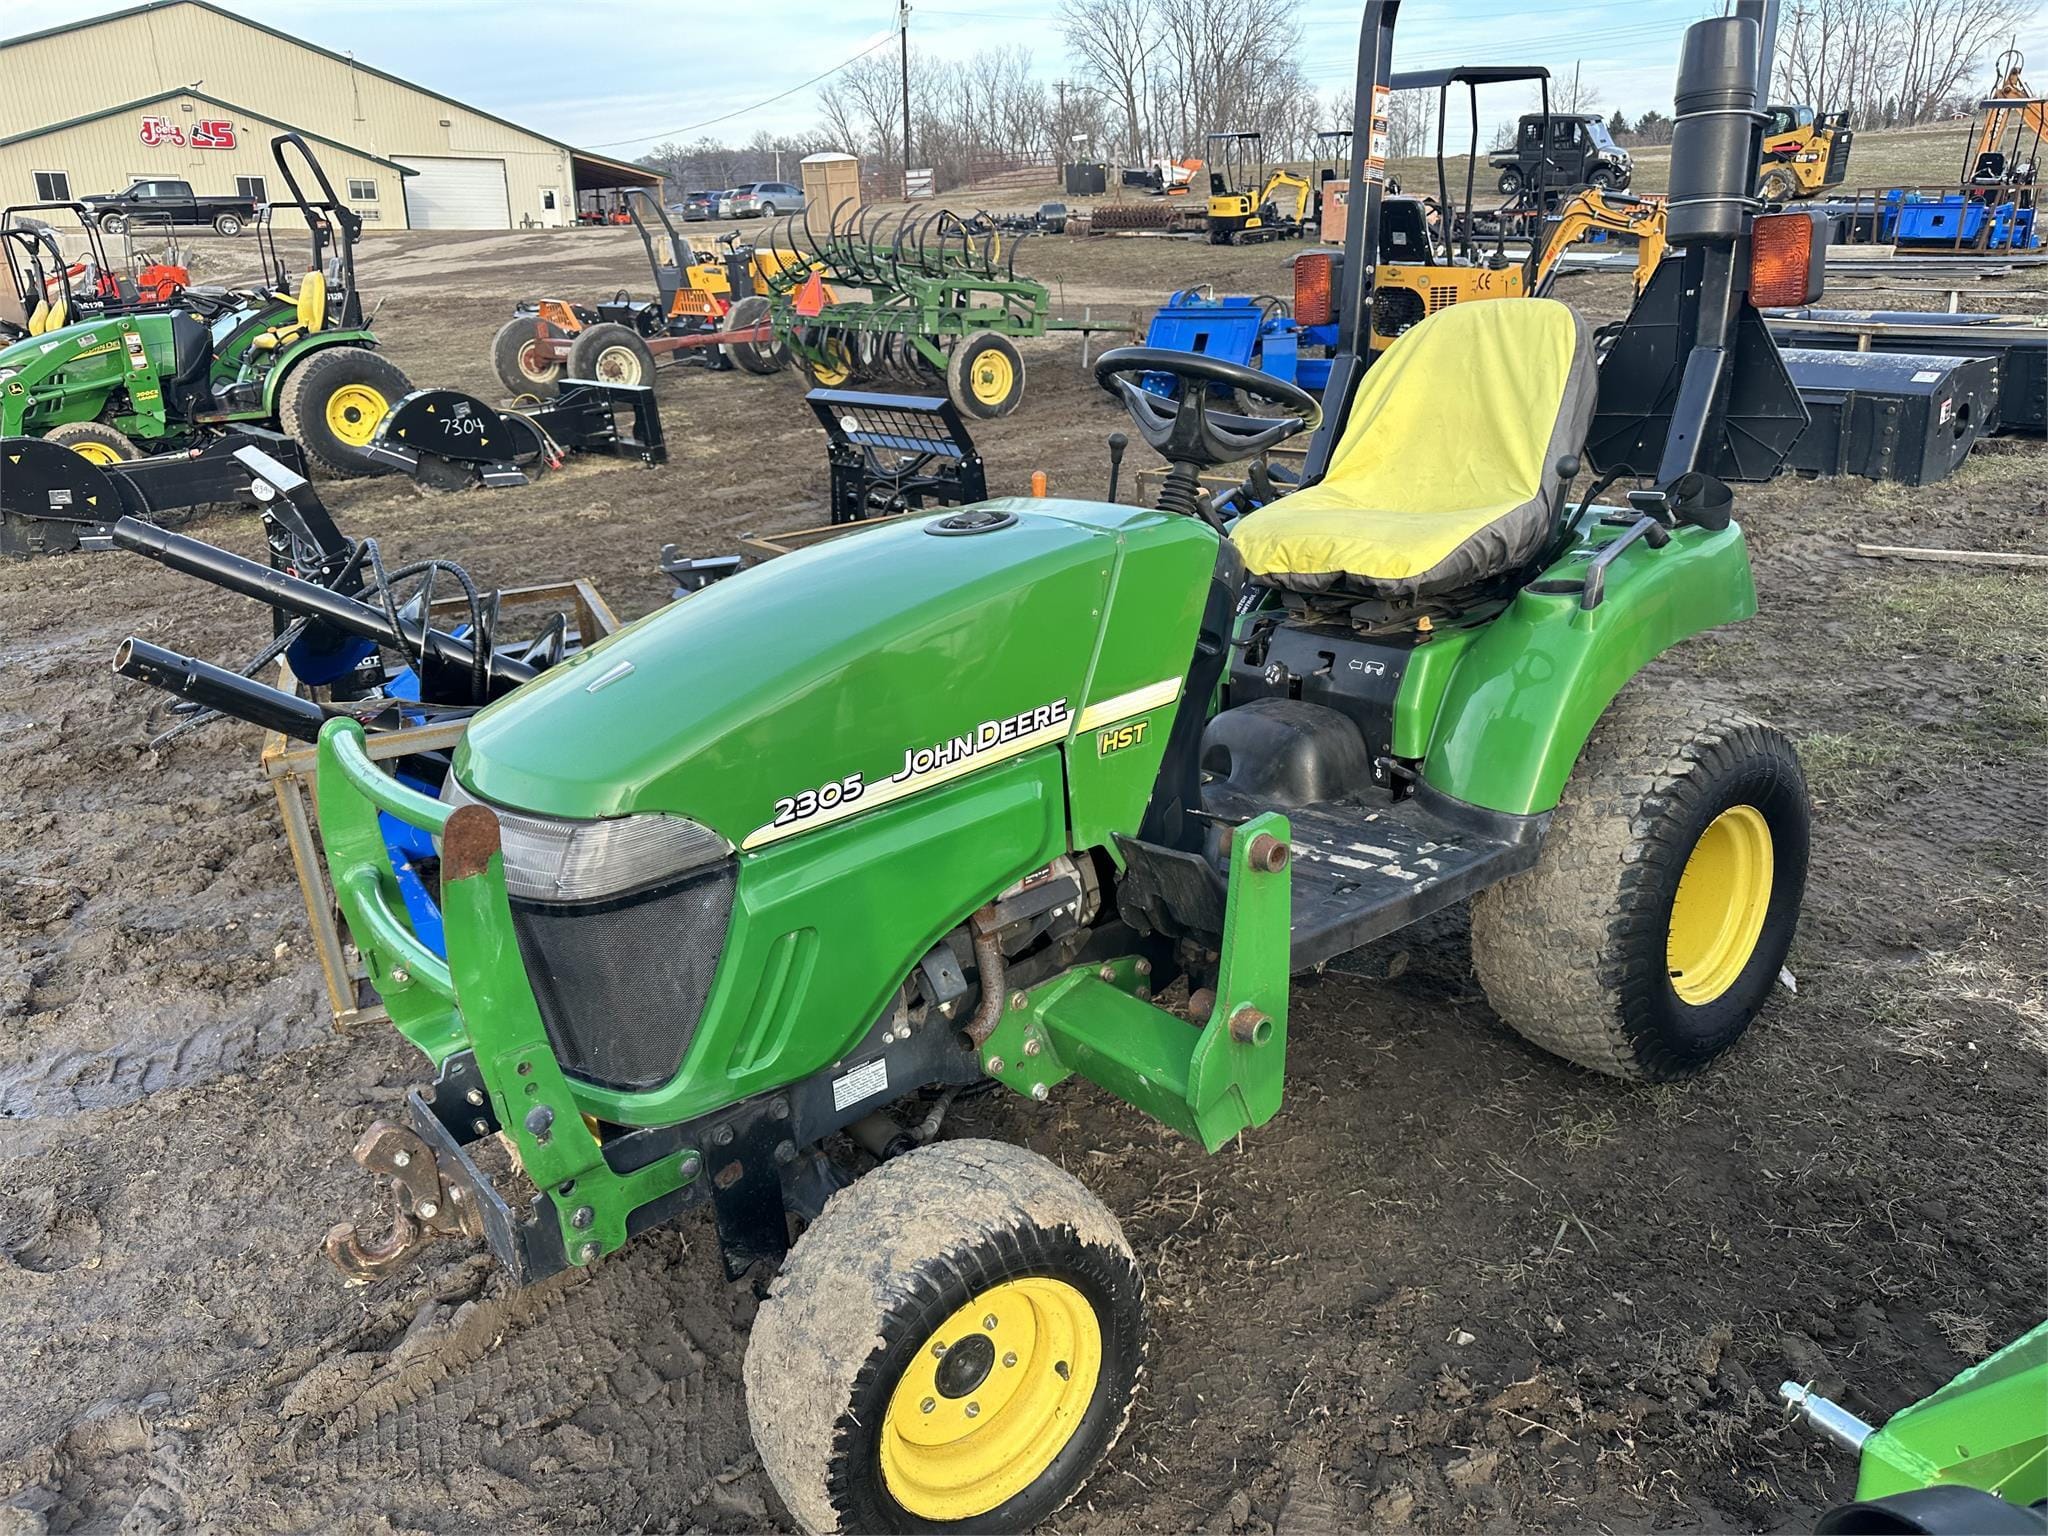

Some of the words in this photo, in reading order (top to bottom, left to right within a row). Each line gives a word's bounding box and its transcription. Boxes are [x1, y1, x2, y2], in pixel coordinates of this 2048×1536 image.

[440, 417, 485, 436] 7304
[892, 731, 974, 783] JOHN
[976, 697, 1068, 753] DEERE
[1102, 720, 1148, 755] HST
[774, 771, 865, 828] 2305
